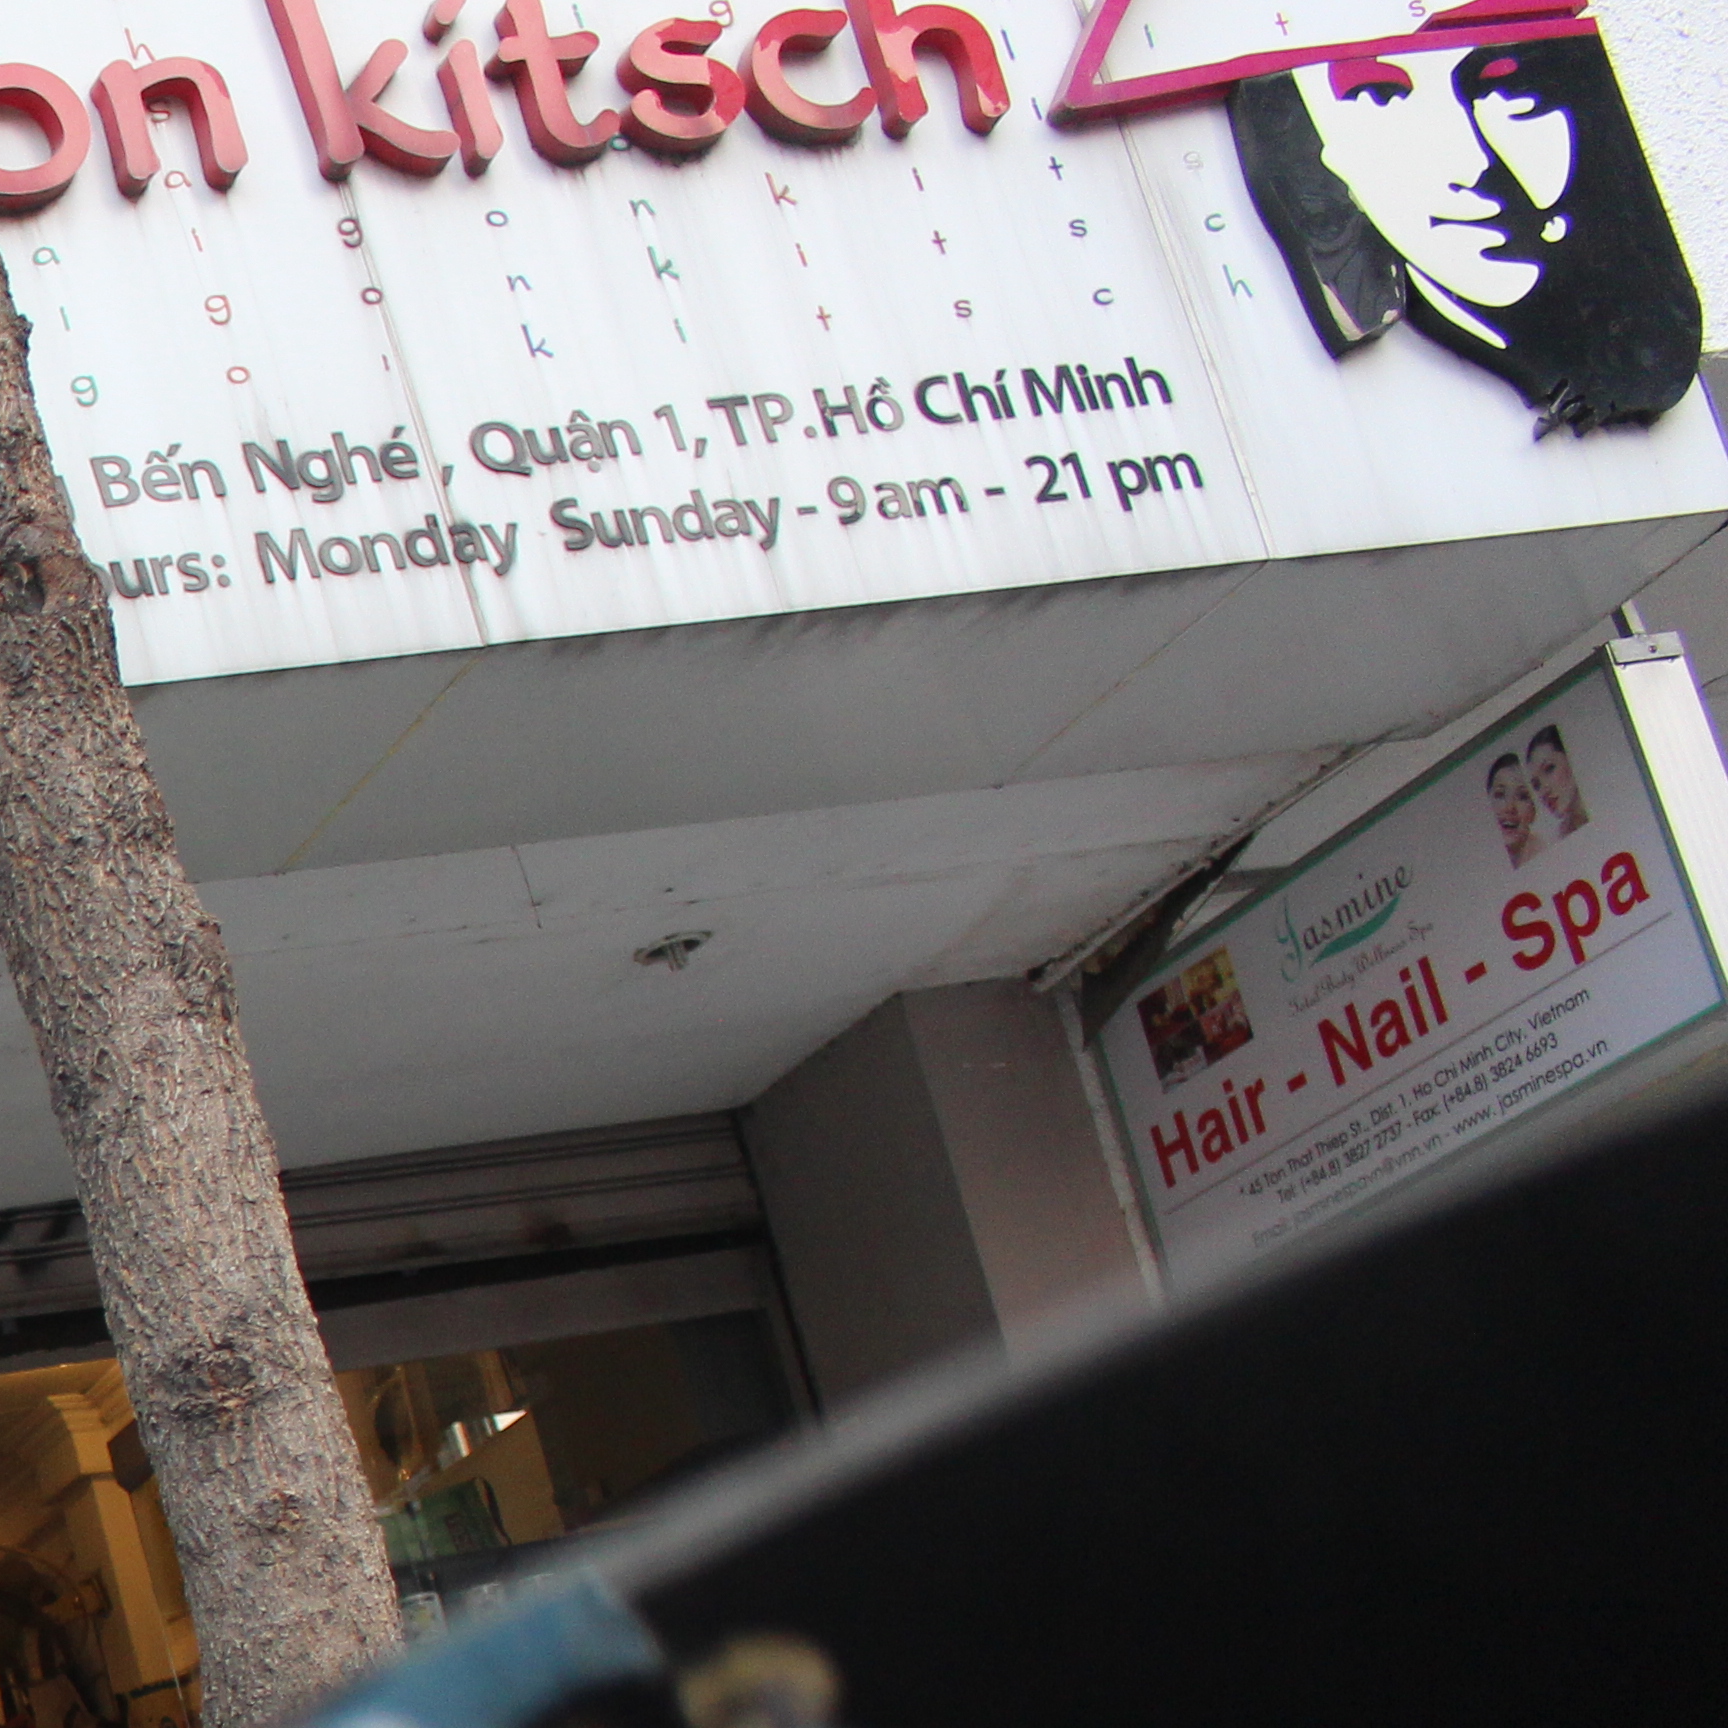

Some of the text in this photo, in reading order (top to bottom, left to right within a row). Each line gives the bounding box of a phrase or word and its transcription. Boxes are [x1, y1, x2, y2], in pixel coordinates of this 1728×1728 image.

[266, 0, 1011, 182] kitsch
[90, 443, 226, 507] Bến
[470, 410, 643, 474] Quận
[913, 368, 1017, 424] Chí
[1020, 356, 1174, 417] Minh
[253, 513, 518, 577] Monday
[551, 482, 781, 552] Sunday
[1024, 452, 1091, 504] 21
[1107, 450, 1204, 512] pm
[1275, 864, 1415, 985] Jasmine
[1149, 1072, 1267, 1188] Hair
[1316, 955, 1449, 1089] Nail
[1500, 849, 1651, 971] Spa
[1458, 1043, 1495, 1073] Minh
[1527, 987, 1591, 1032] Vietnam
[1489, 1052, 1524, 1084] 3824
[1524, 1031, 1559, 1064] 6693
